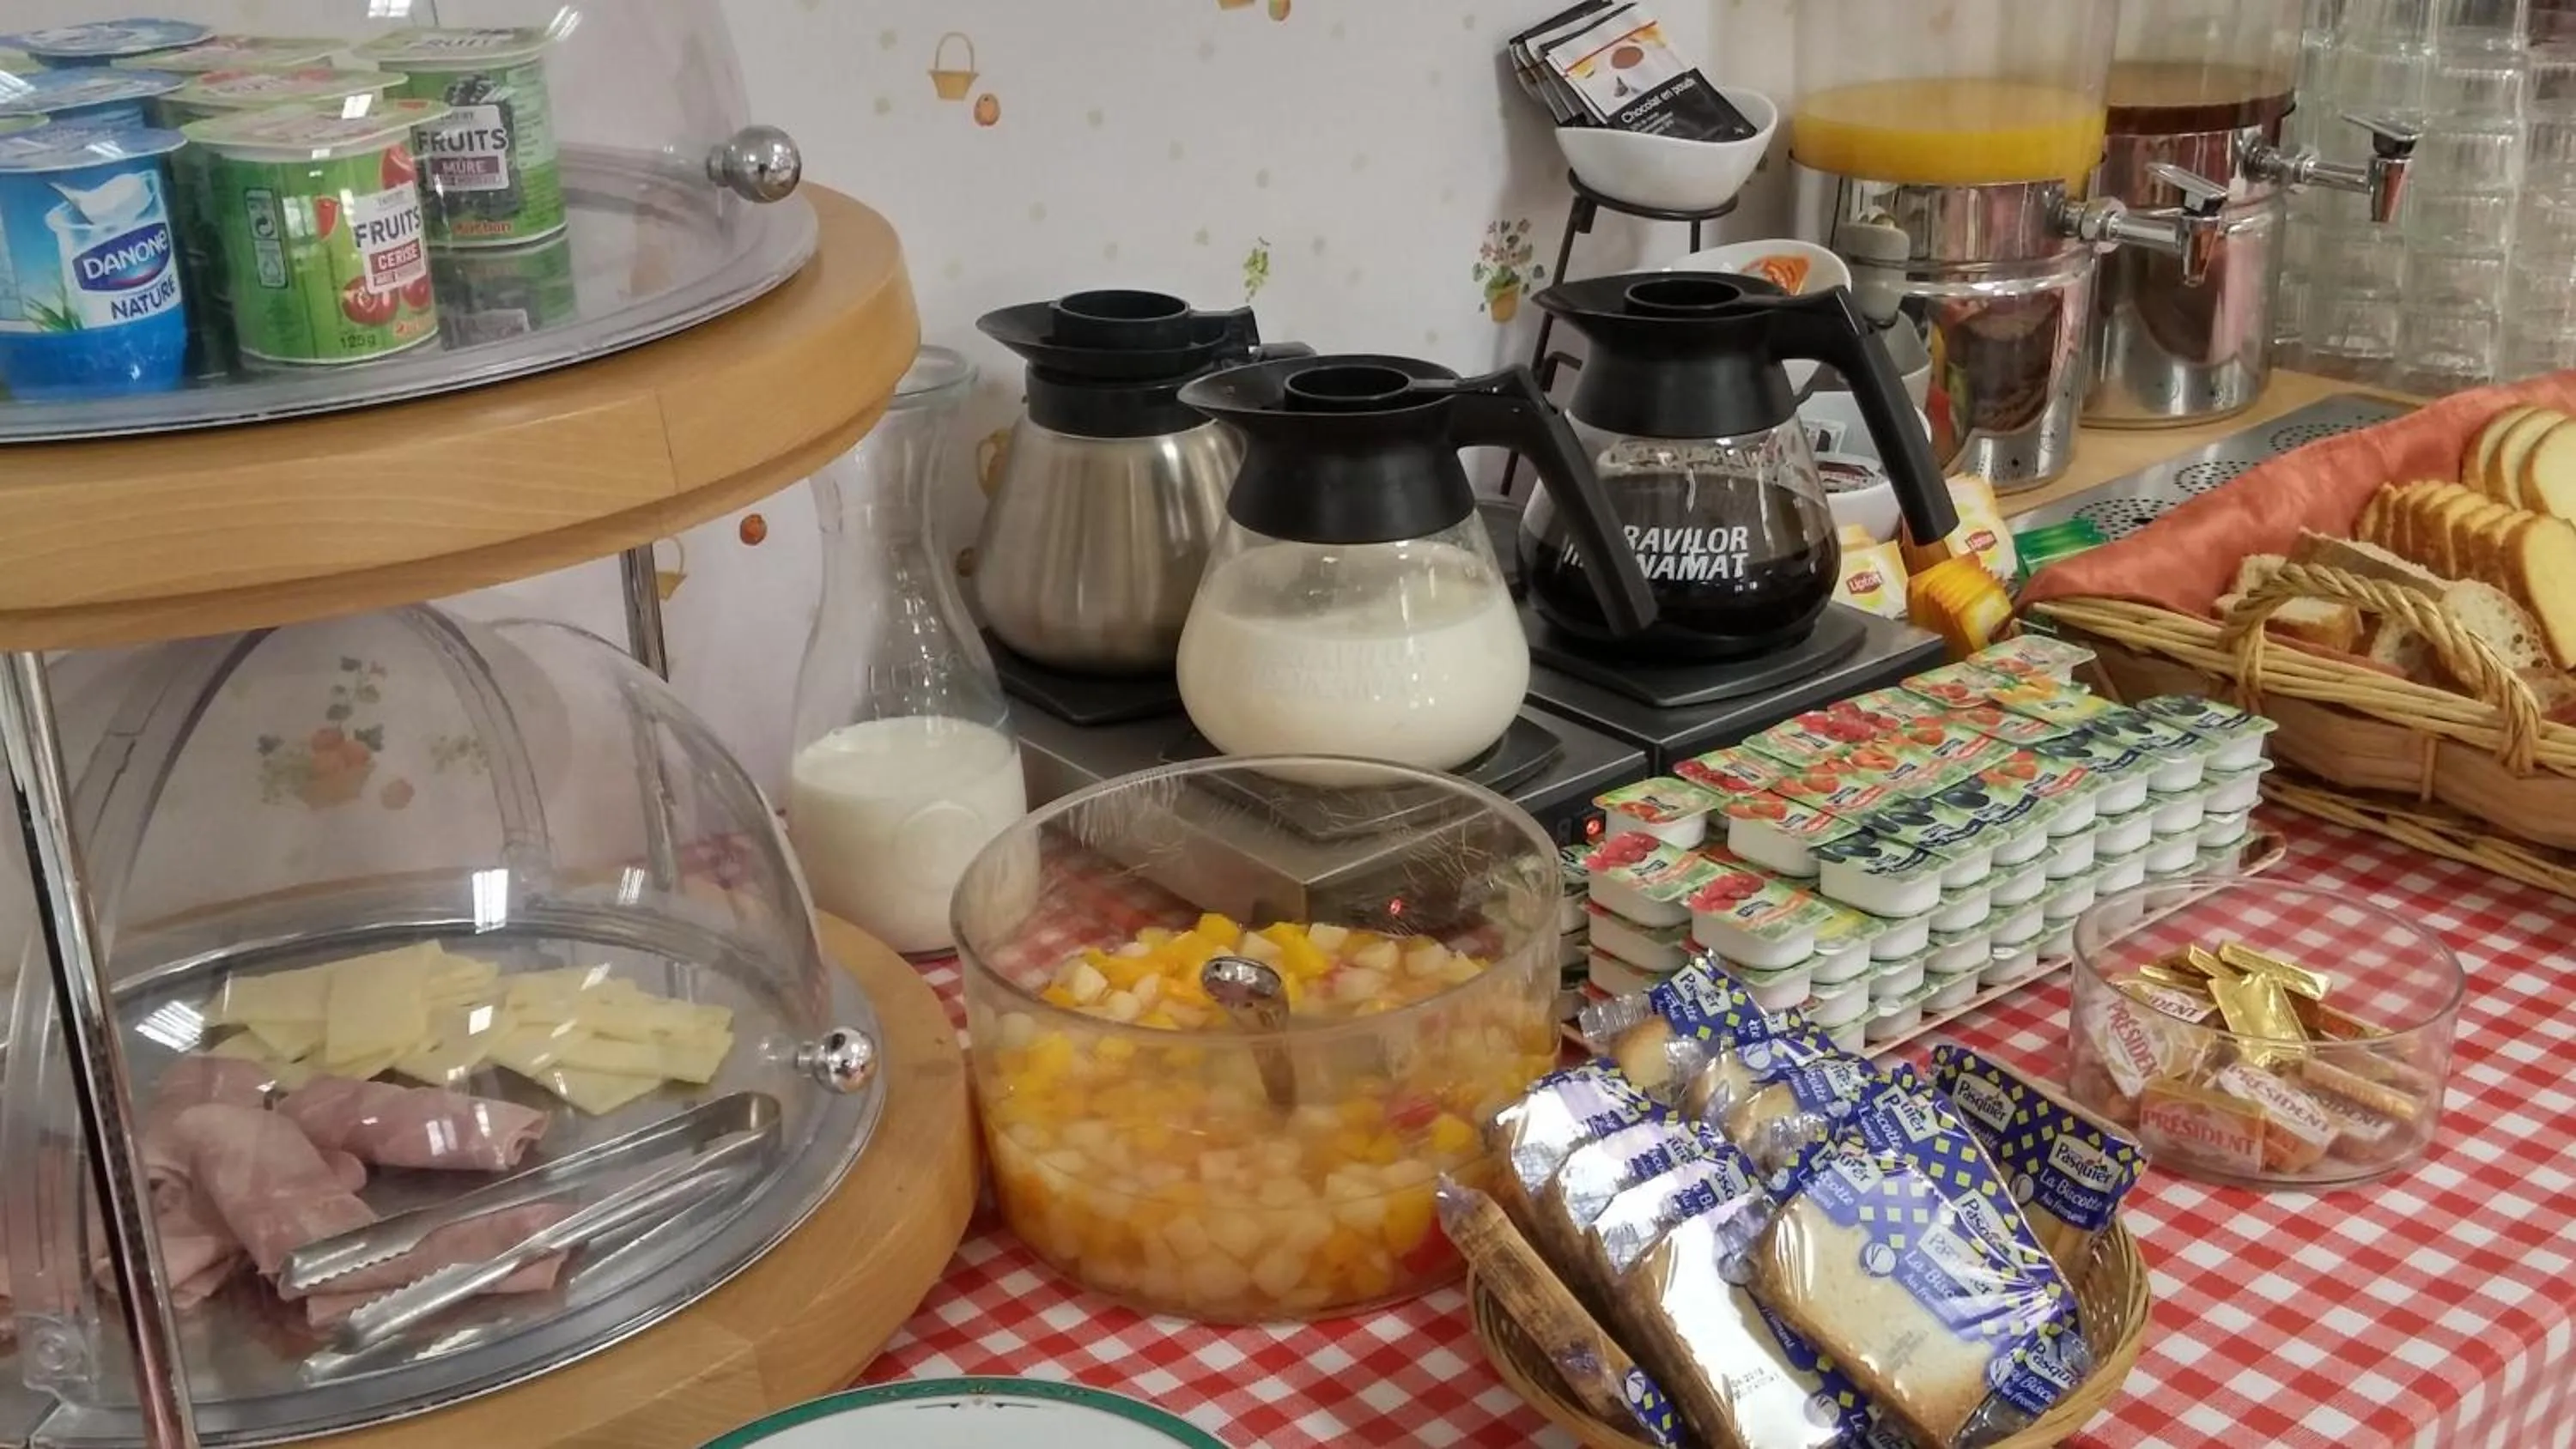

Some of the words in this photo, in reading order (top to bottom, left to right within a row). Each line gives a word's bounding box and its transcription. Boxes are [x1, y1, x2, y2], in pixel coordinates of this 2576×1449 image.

[1621, 95, 1662, 123] Chocolat
[1661, 88, 1674, 101] en
[416, 129, 507, 152] FRUITS
[354, 205, 420, 248] FRUITS
[379, 243, 418, 270] CERISE
[110, 274, 176, 320] NATURE
[1623, 525, 1748, 554] RAVILOR
[1635, 552, 1749, 580] NAMAT
[1849, 572, 1881, 592] Lipton
[2107, 997, 2165, 1078] PRÉSIDEN
[1958, 1080, 2007, 1122] Pasquier
[2227, 1064, 2330, 1133] PRÉSIDENT
[2142, 1109, 2256, 1156] PRÉSIDENT
[2056, 1143, 2112, 1185] Pasquier
[2039, 1168, 2056, 1189] La
[2057, 1179, 2103, 1210] Biscotte
[1905, 1249, 1925, 1274] La
